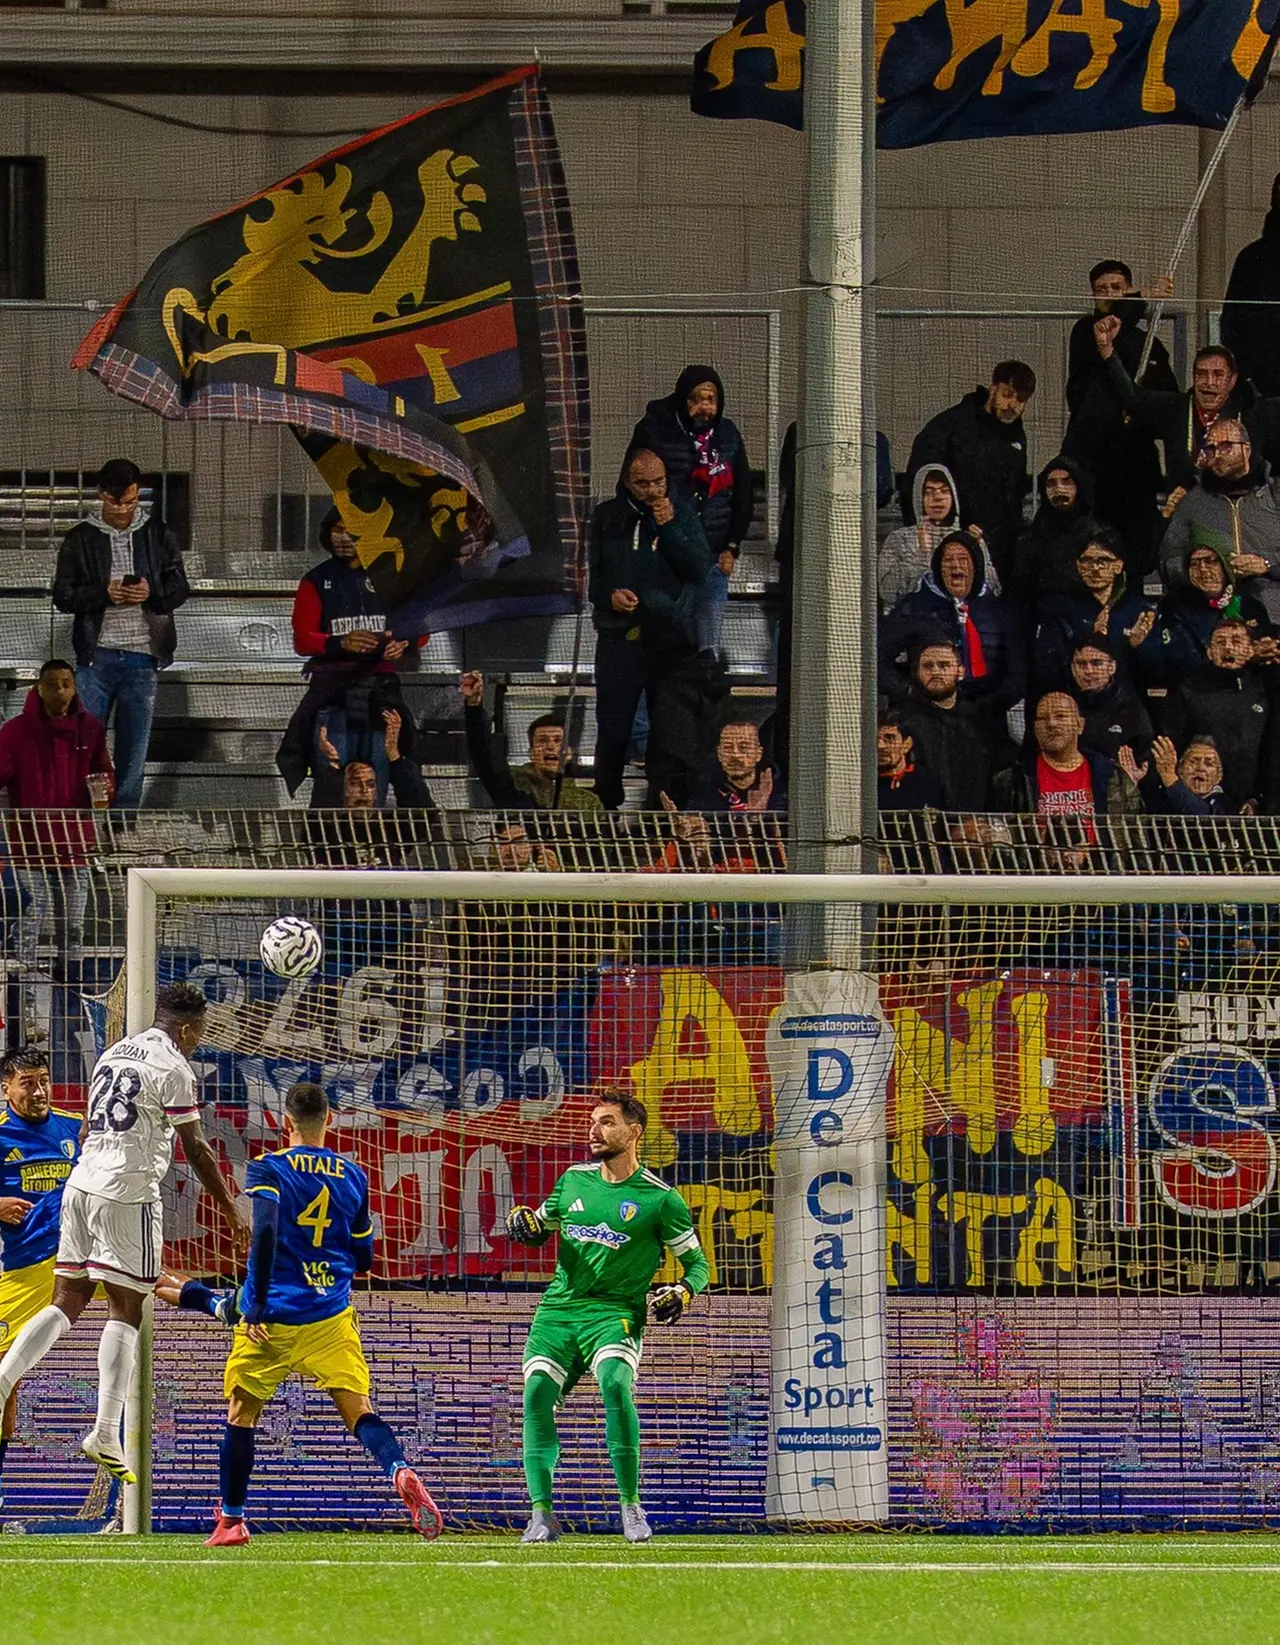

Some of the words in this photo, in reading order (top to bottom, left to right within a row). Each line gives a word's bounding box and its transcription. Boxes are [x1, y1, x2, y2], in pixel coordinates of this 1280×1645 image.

[90, 1065, 141, 1132] 28
[286, 1154, 346, 1179] VITALE
[297, 1184, 333, 1247] 4
[567, 1226, 627, 1243] PROSHOP
[783, 1378, 874, 1418] Sport
